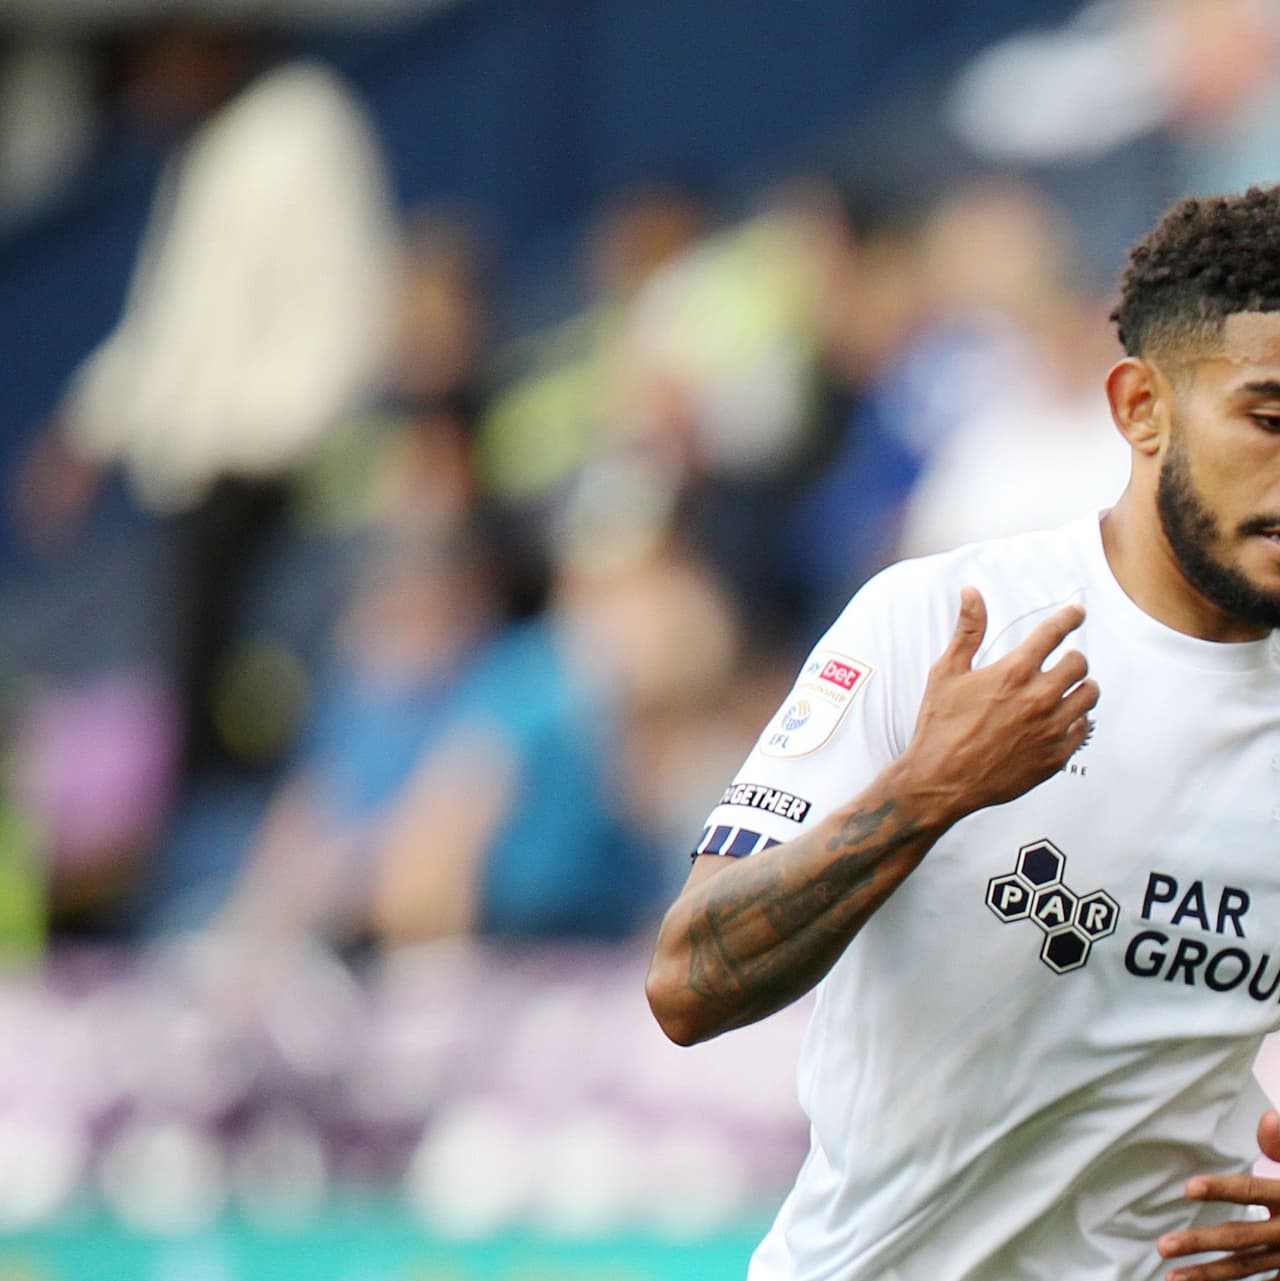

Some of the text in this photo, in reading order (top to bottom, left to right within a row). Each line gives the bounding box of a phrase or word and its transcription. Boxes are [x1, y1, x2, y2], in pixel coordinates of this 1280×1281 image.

[823, 662, 858, 686] bet
[720, 783, 807, 821] GETHER
[1000, 884, 1108, 931] PAR
[1141, 872, 1250, 938] PAR
